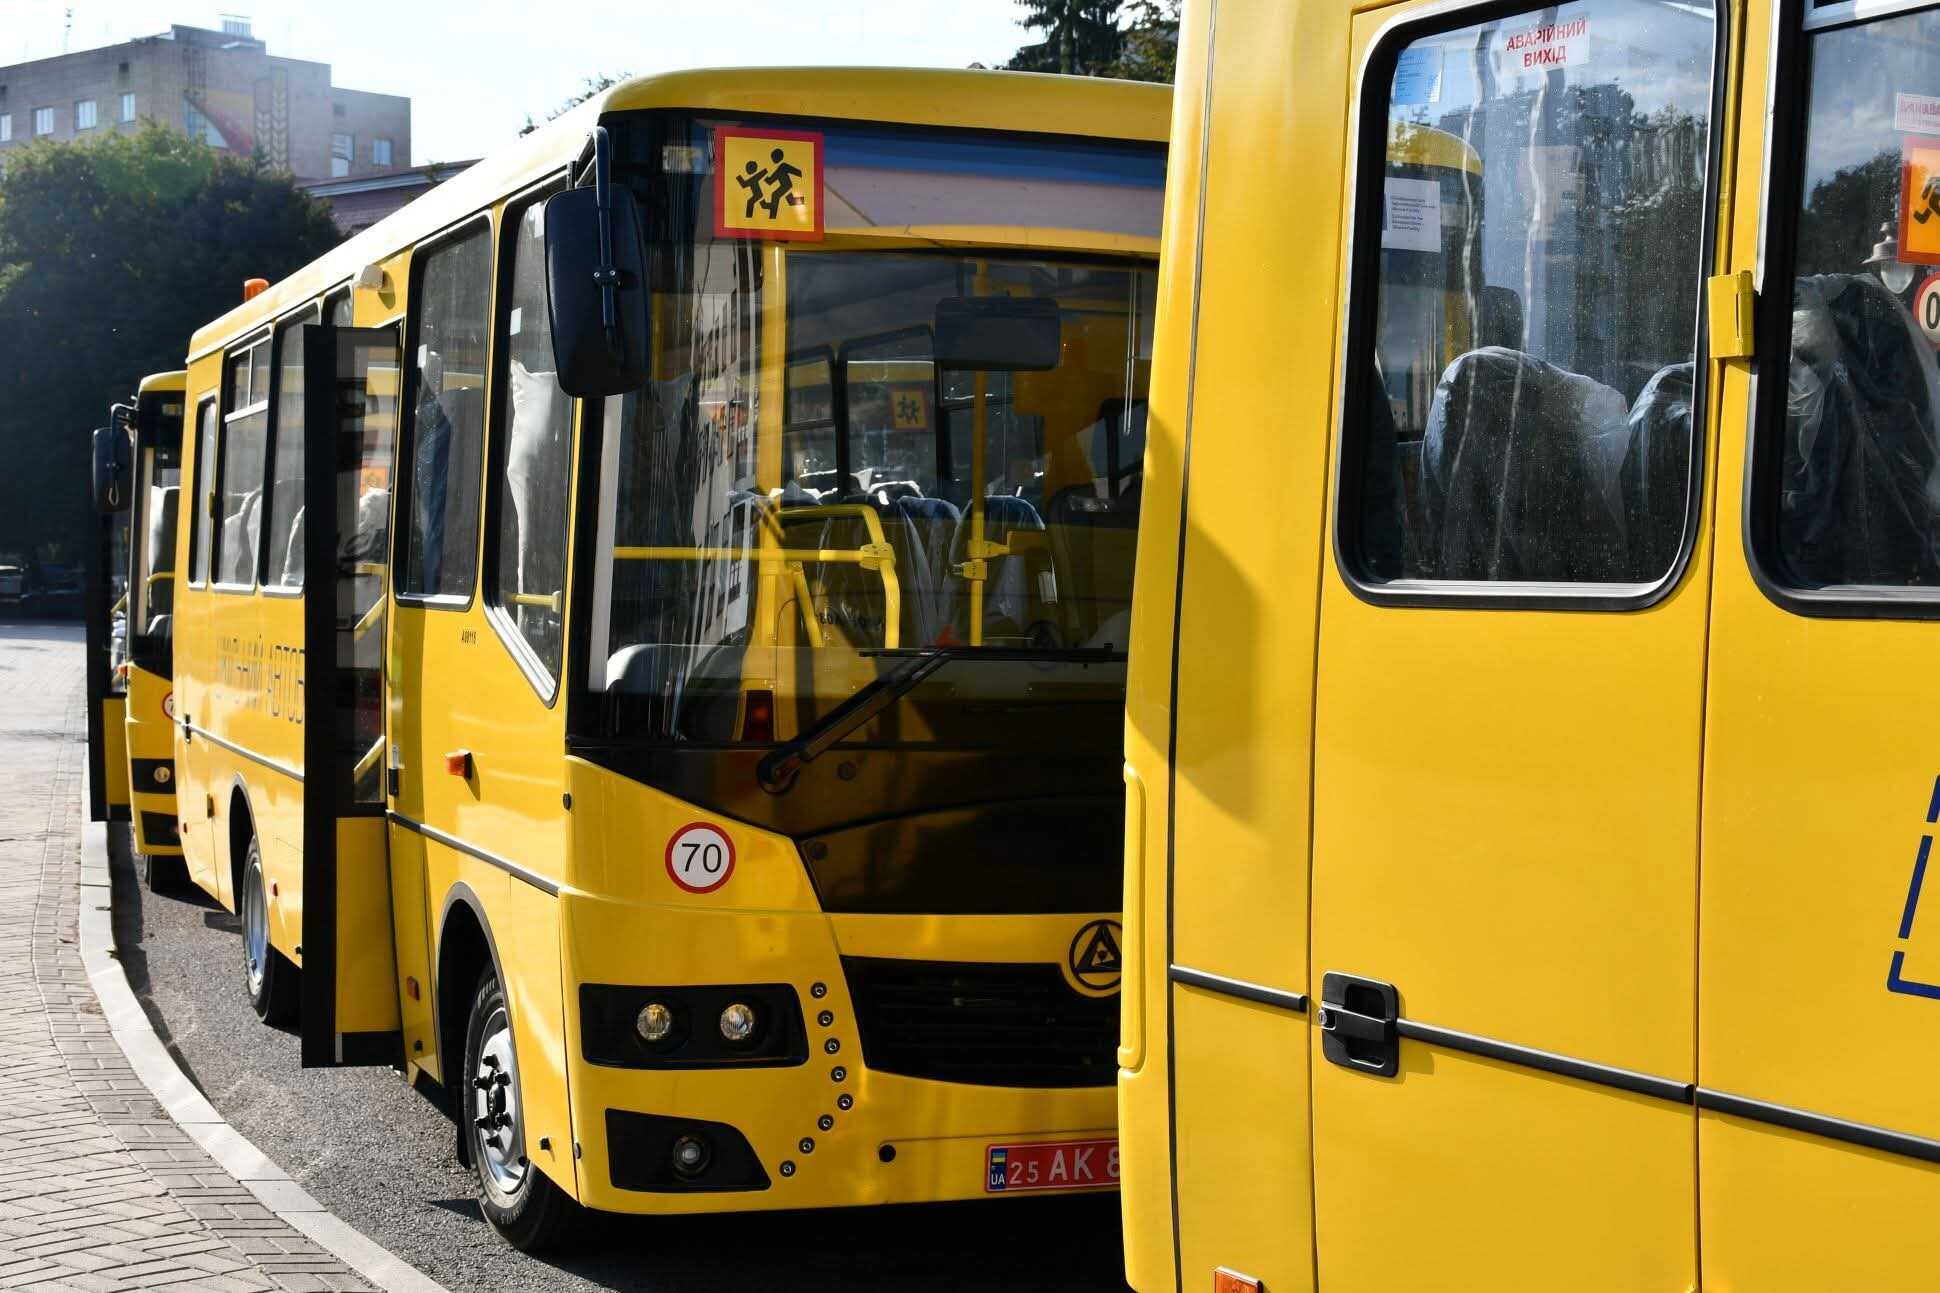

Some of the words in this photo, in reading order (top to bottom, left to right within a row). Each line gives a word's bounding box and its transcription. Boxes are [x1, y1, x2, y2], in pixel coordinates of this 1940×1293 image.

[1506, 17, 1586, 52] АВАРІЙНИЙ
[1524, 45, 1567, 68] ВИХІД
[681, 843, 722, 874] 70
[991, 1173, 1006, 1185] UA
[1009, 1160, 1039, 1185] 25
[1048, 1147, 1096, 1181] AK
